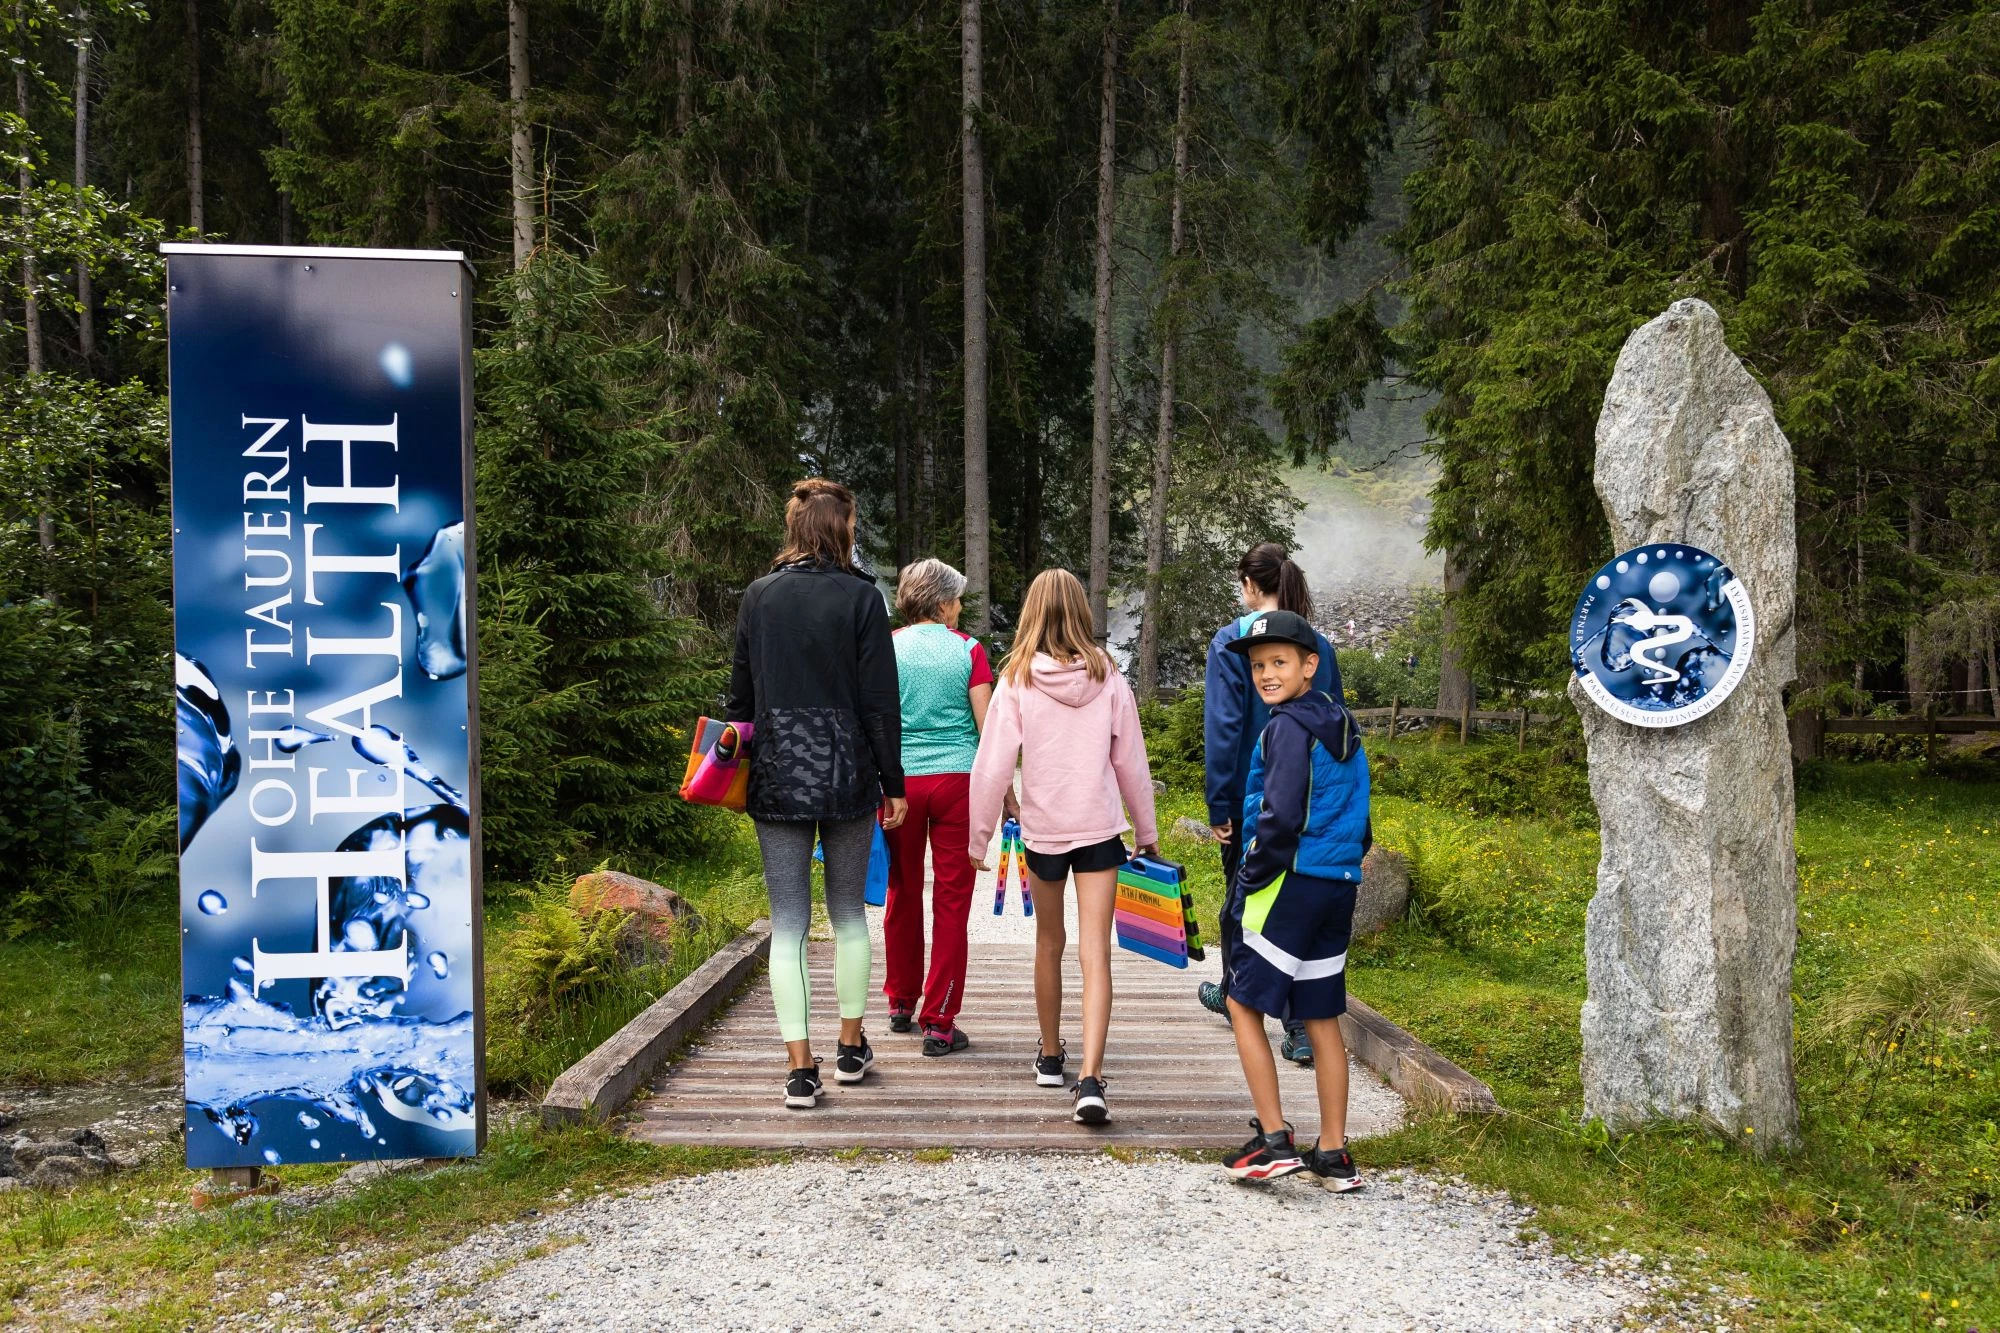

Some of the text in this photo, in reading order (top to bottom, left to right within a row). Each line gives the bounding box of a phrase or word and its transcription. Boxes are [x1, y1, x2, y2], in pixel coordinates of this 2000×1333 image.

[241, 412, 294, 669] TAUERN
[1575, 594, 1596, 671] PARTNER DER
[1587, 678, 1638, 720] PARACELSUS
[1640, 693, 1724, 724] MEDIZINISCHEN
